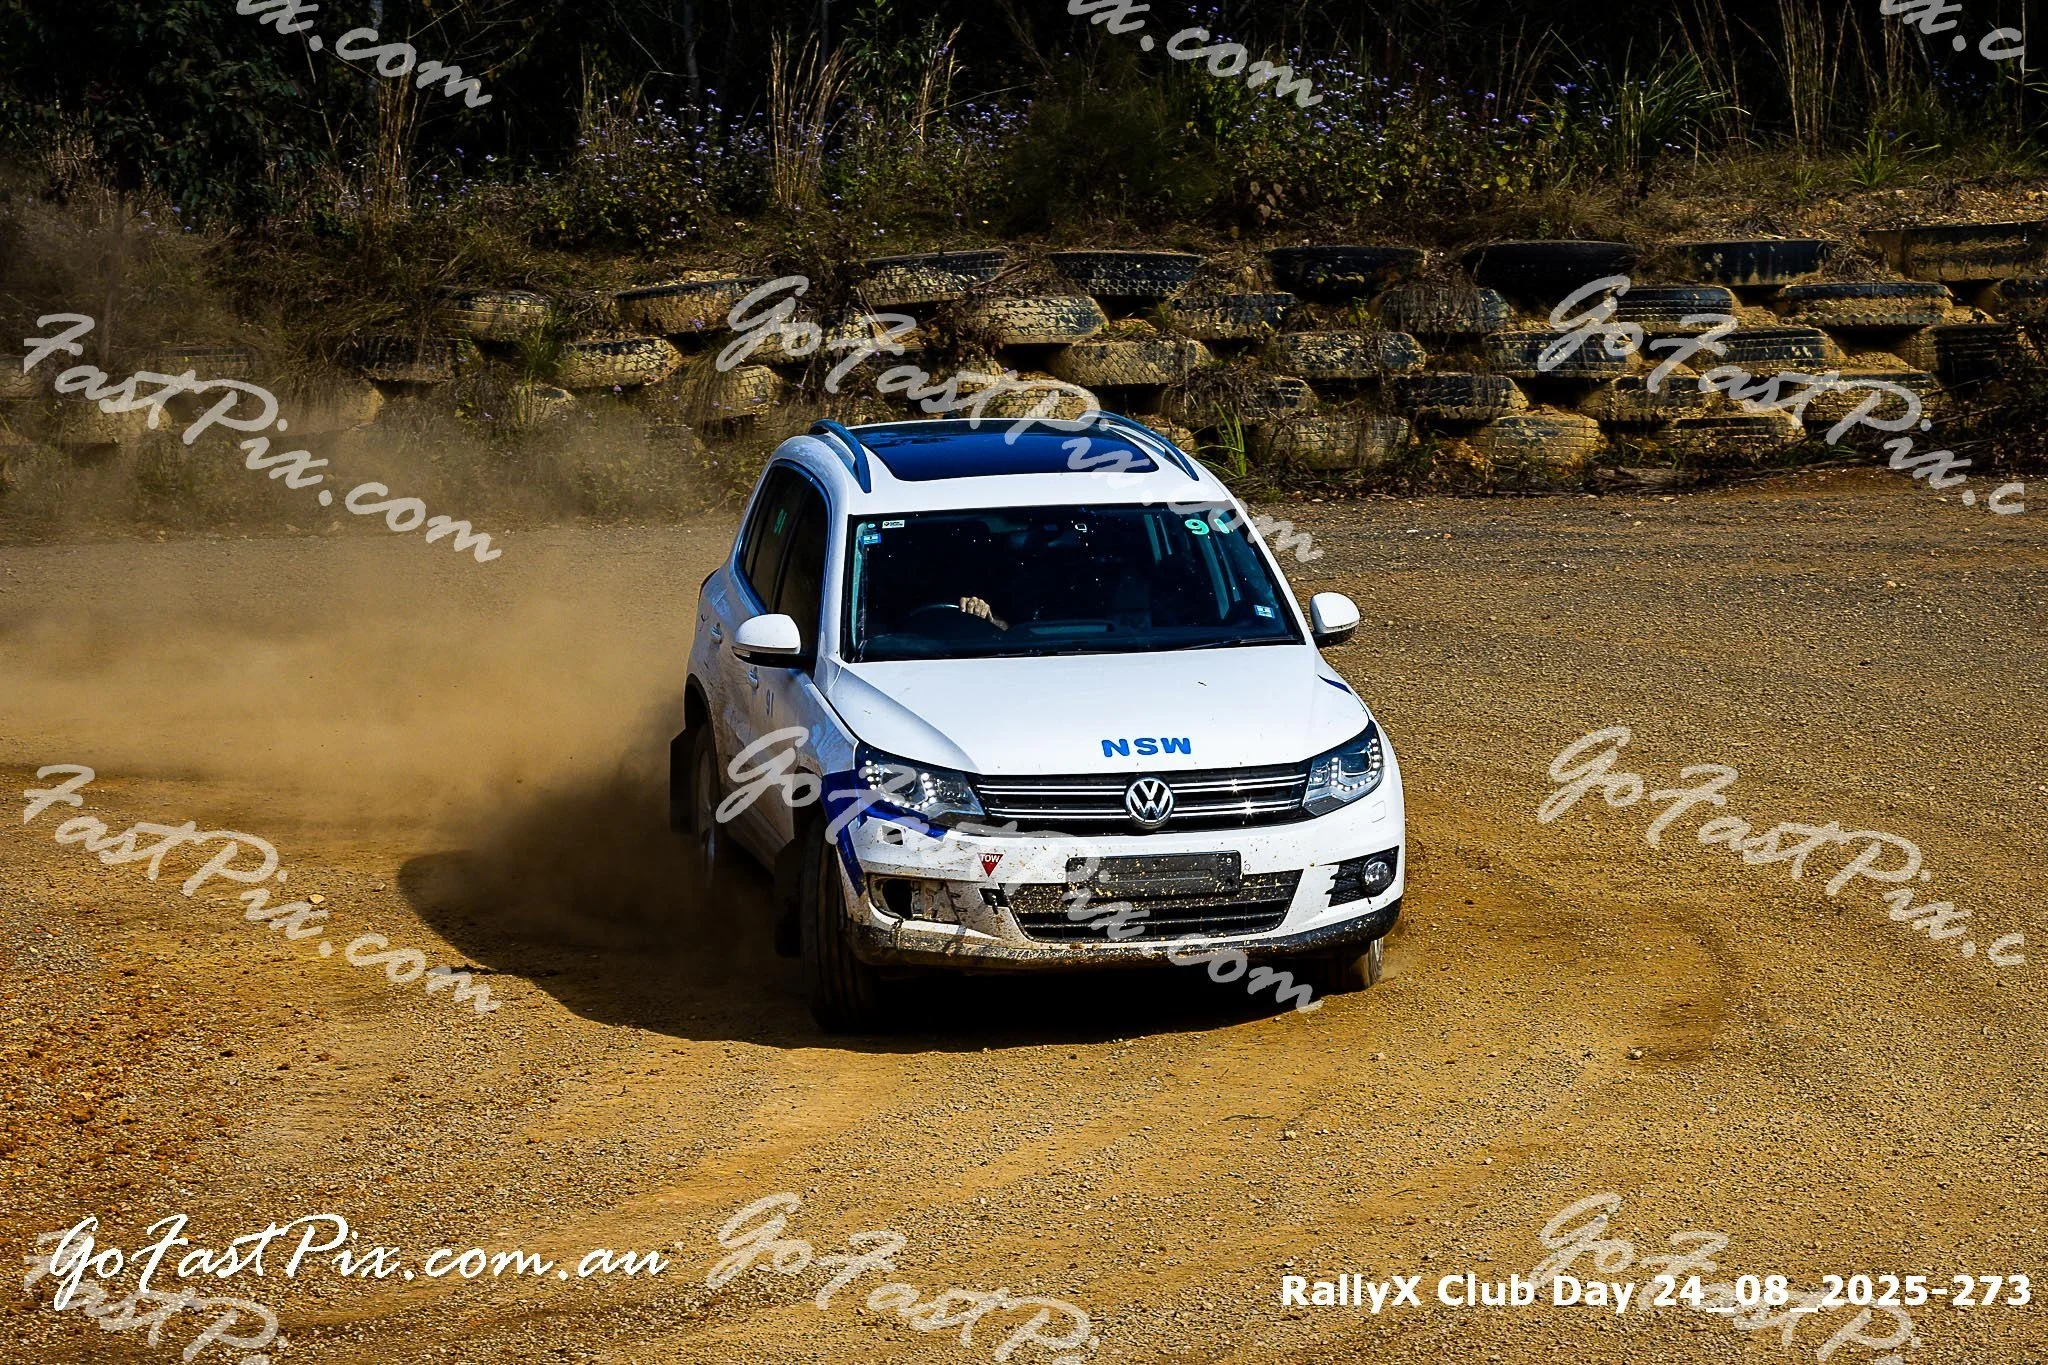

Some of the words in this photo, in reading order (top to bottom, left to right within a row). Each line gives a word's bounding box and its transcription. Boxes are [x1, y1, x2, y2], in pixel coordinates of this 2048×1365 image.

[1184, 518, 1230, 535] 91
[1101, 737, 1191, 758] NSW
[1126, 777, 1174, 823] VW
[980, 853, 1001, 863] TOW
